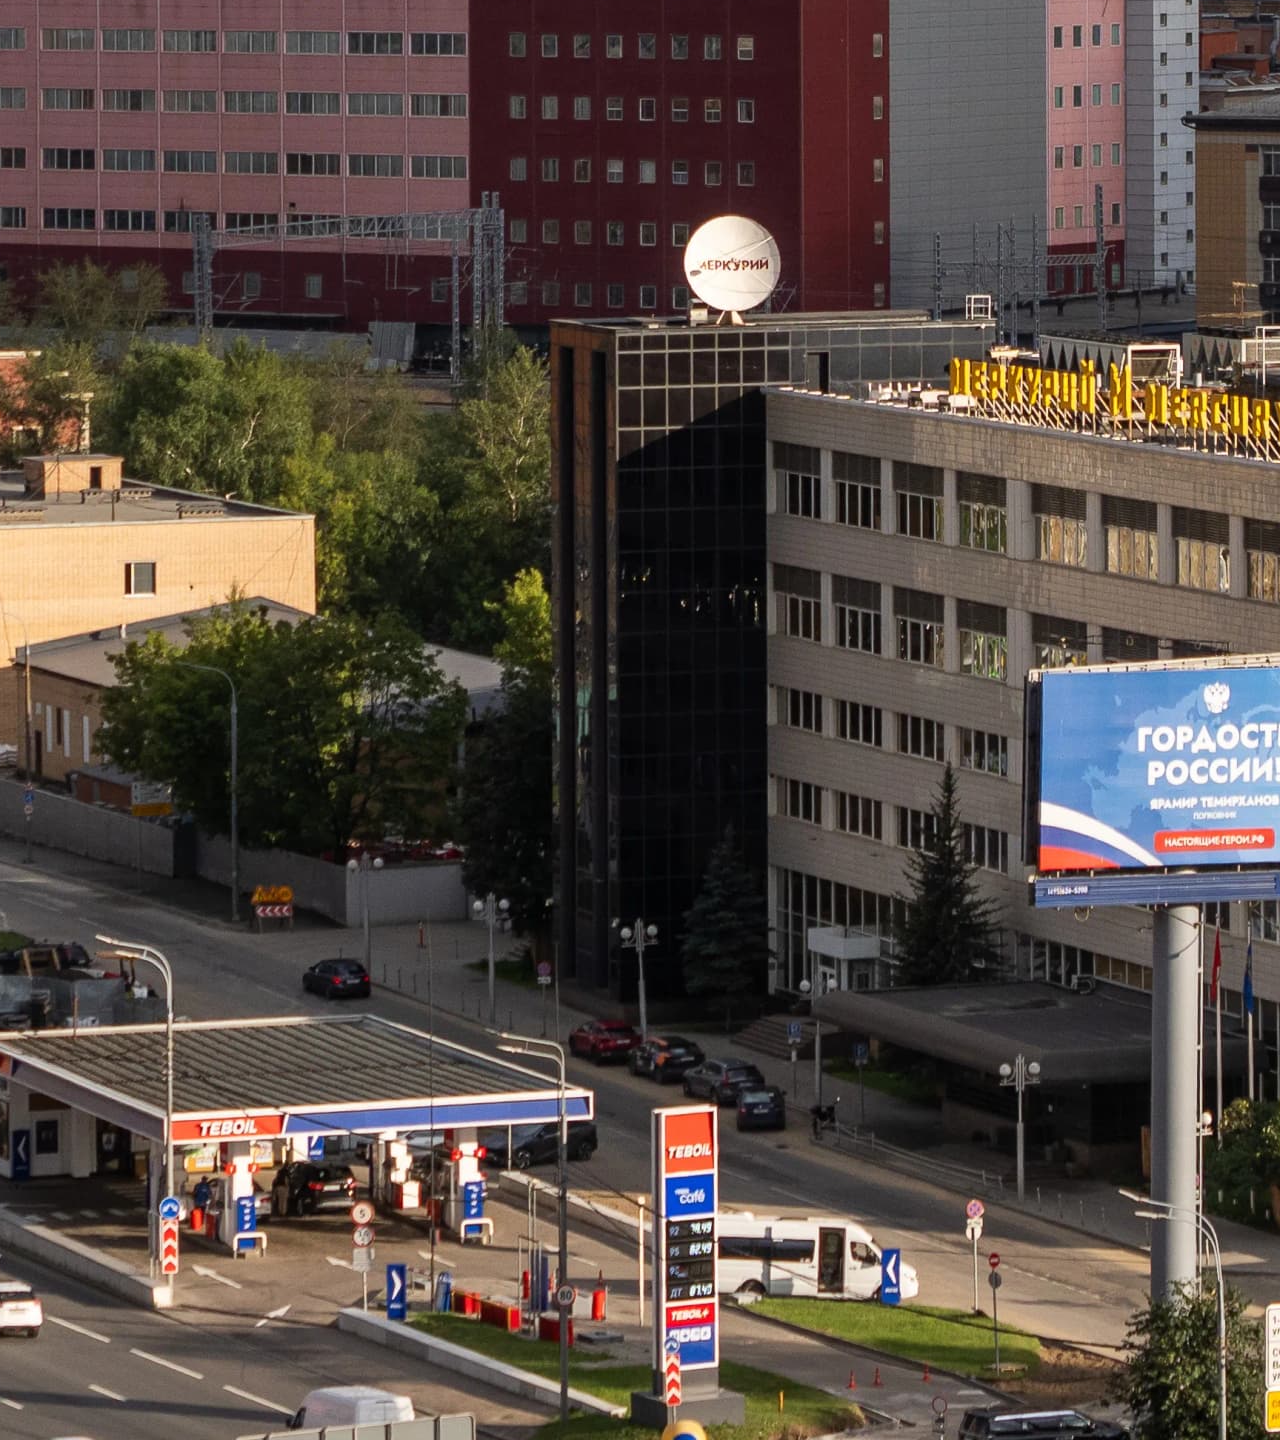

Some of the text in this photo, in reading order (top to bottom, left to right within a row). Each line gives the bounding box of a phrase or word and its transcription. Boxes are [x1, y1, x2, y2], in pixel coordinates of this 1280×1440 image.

[1200, 794, 1280, 808] ТЕМИРХАНОВ
[1164, 834, 1265, 848] НАСТОЯЩИЕ-ГЕРОИ.РФ
[200, 1119, 258, 1137] TEBOIL
[667, 1143, 711, 1160] TEBOIL
